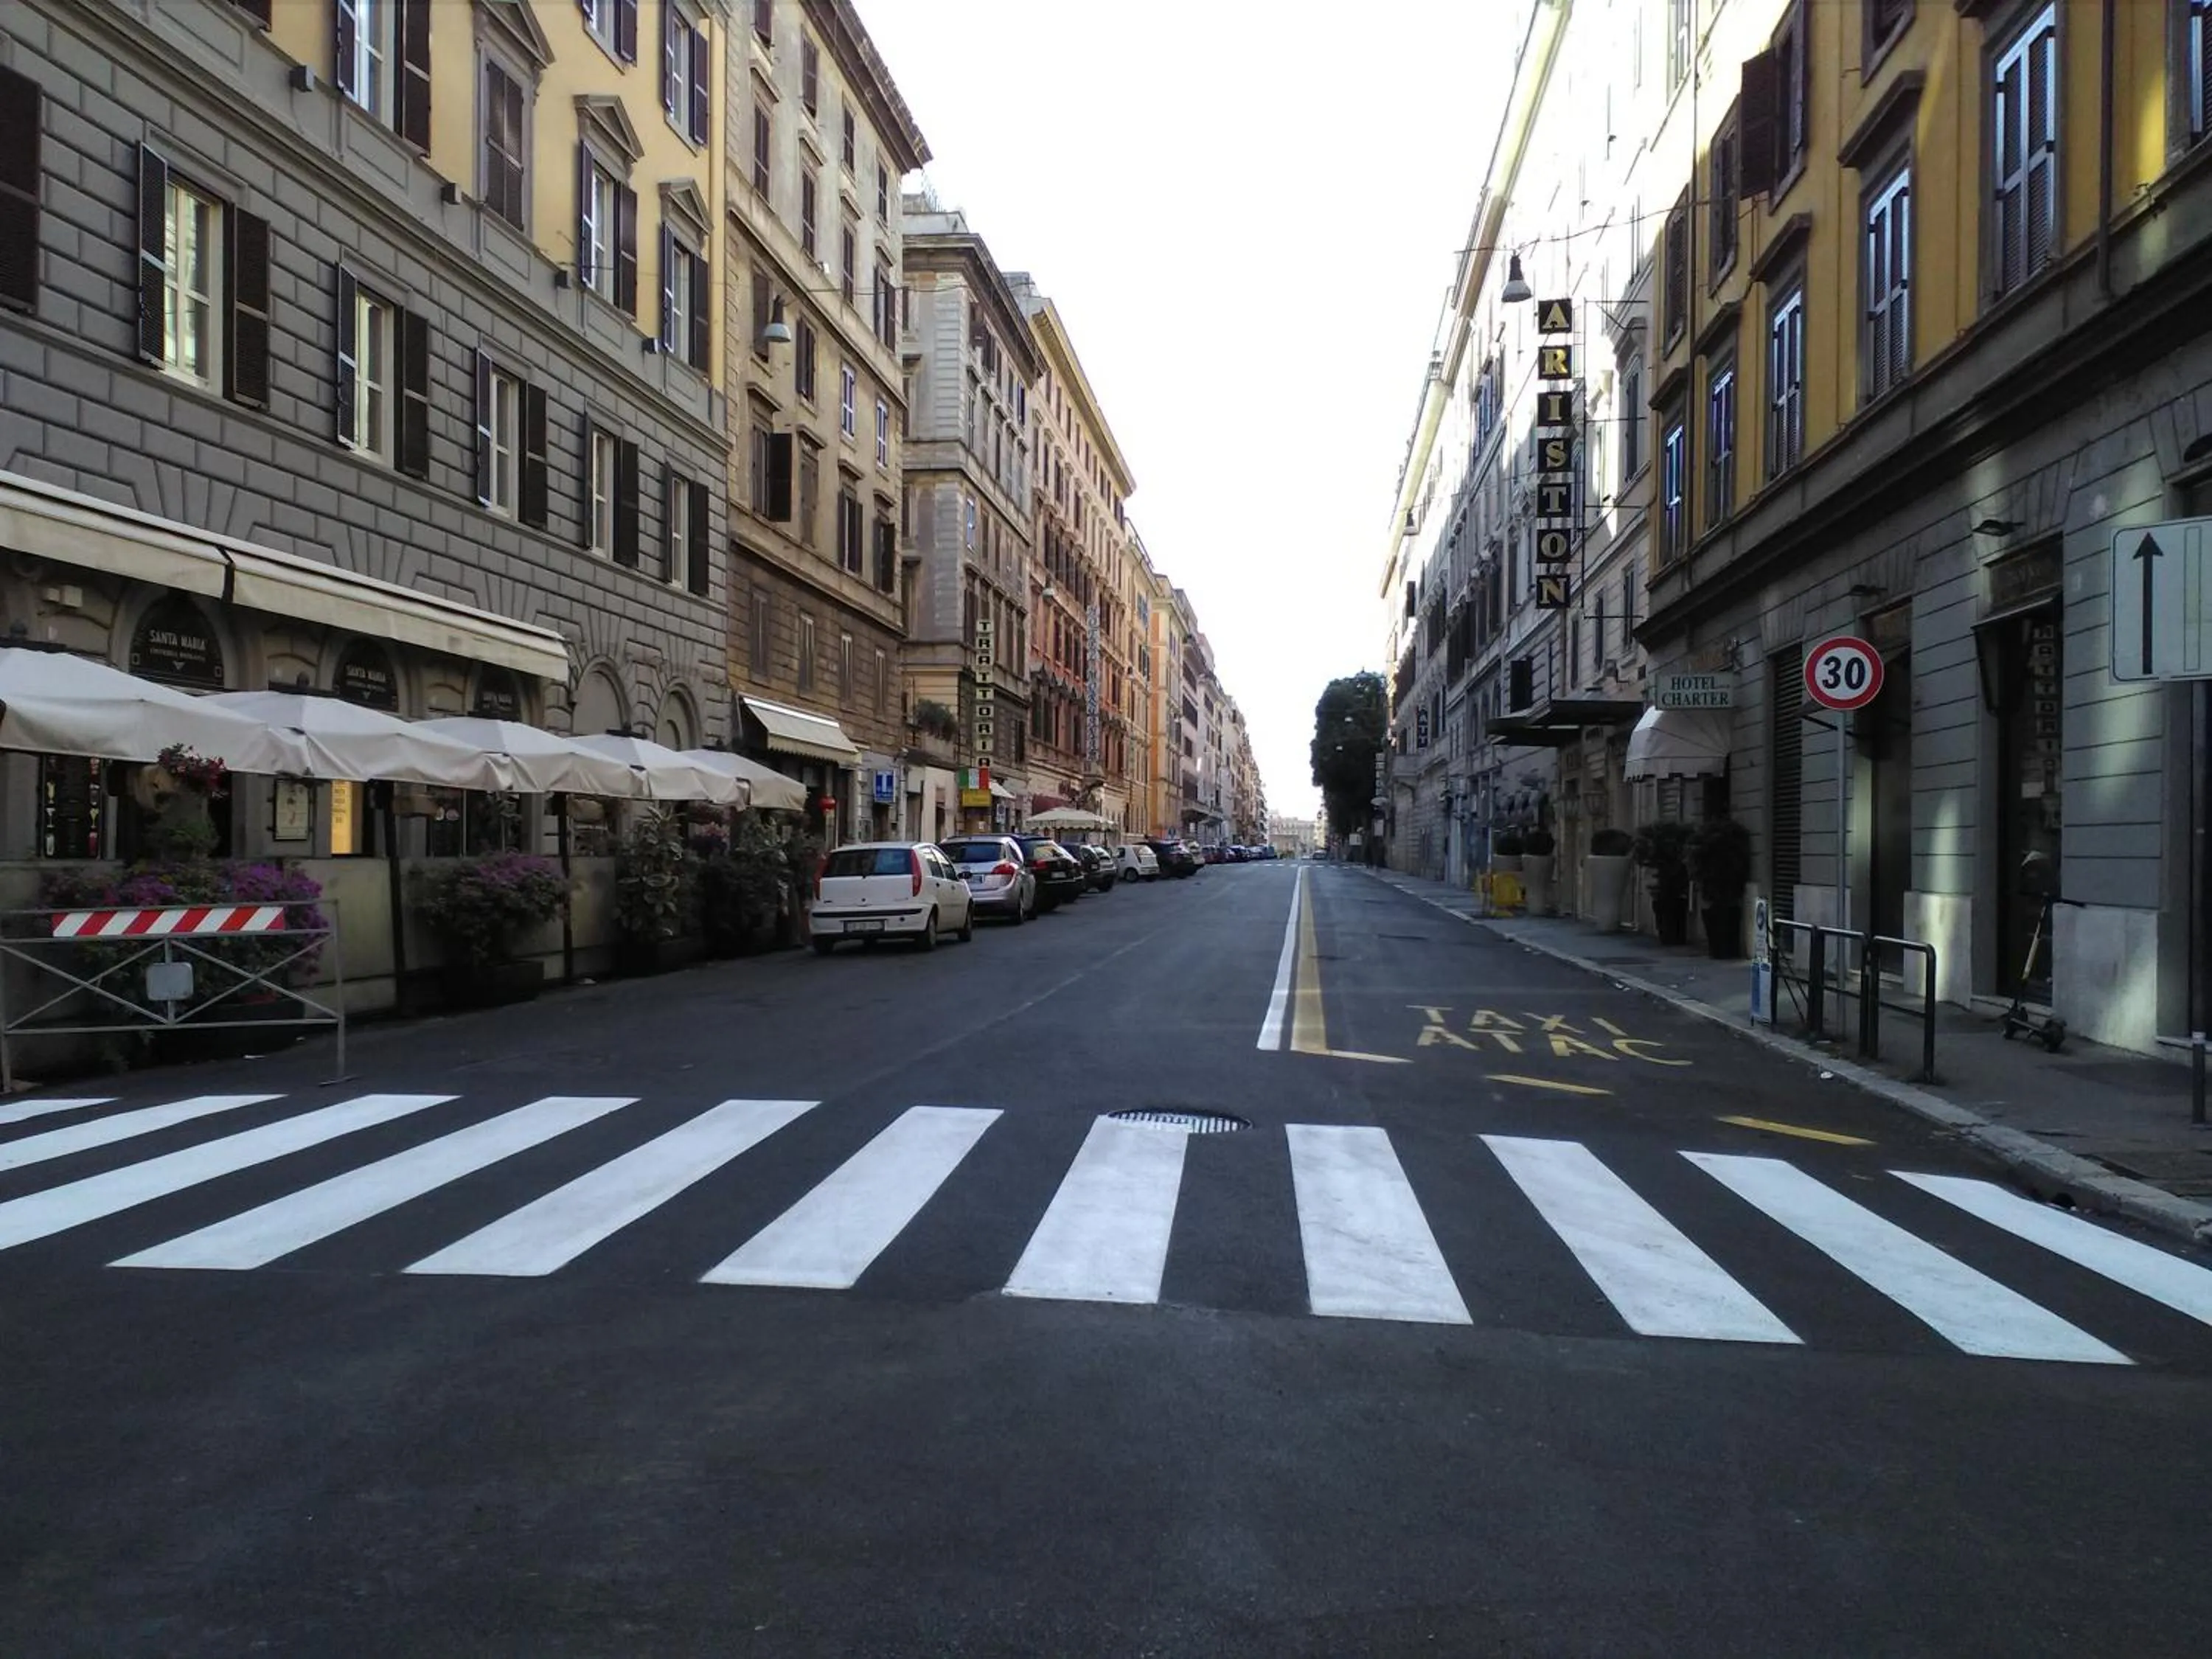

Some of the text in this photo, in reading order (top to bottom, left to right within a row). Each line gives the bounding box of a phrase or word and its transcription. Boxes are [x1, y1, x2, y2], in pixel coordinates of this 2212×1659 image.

[1540, 302, 1571, 605] ARISTON
[149, 630, 206, 651] SANTA MARIA
[1671, 676, 1715, 690] HOTEL
[1822, 655, 1865, 690] 30
[978, 621, 992, 767] TRATTORIA
[1661, 692, 1729, 706] CHARTER
[1406, 1005, 1628, 1036] TAXI
[1416, 1025, 1693, 1066] ATAC
